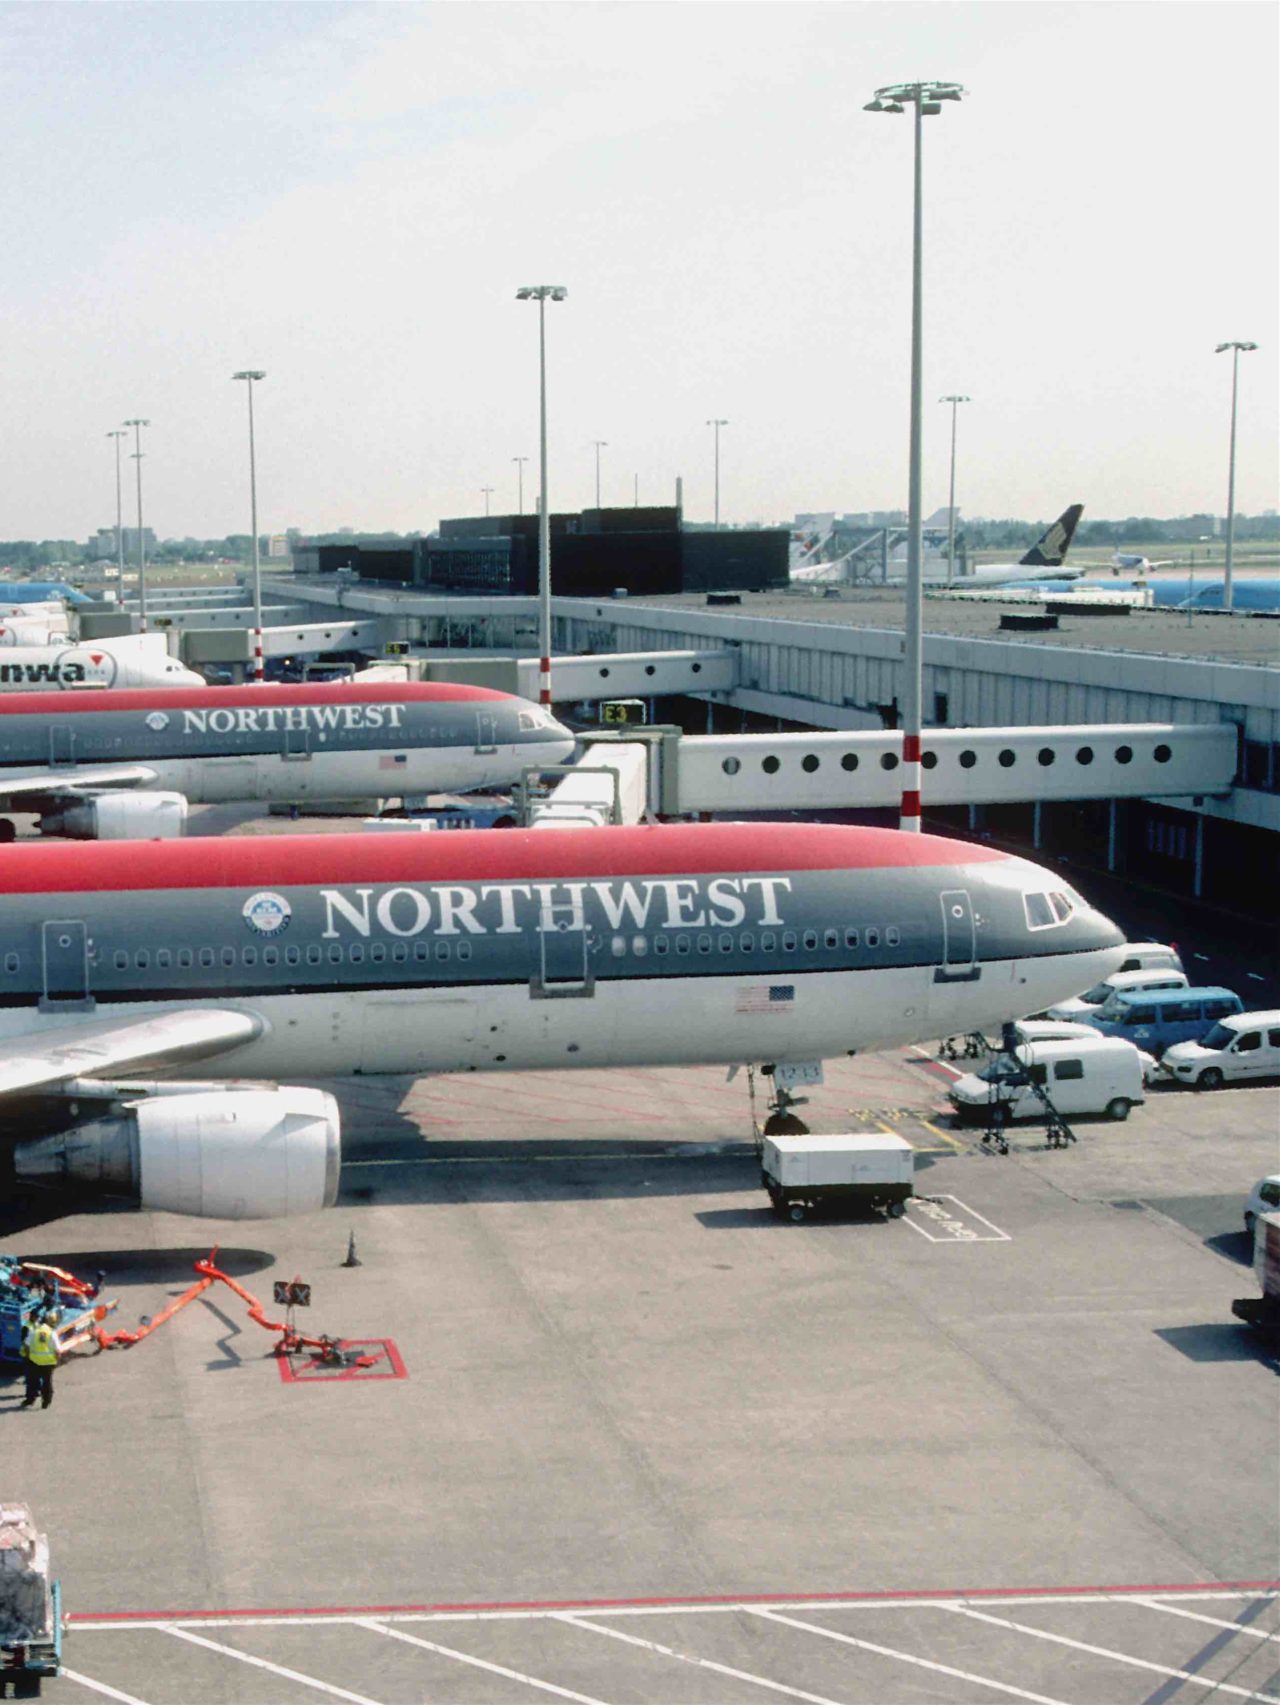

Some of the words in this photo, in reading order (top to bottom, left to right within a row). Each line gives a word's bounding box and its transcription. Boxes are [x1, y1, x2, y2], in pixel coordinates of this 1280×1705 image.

[0, 662, 85, 683] nwa
[183, 704, 406, 734] NORTHWEST
[605, 705, 627, 723] E3
[320, 878, 792, 939] NORTHWEST
